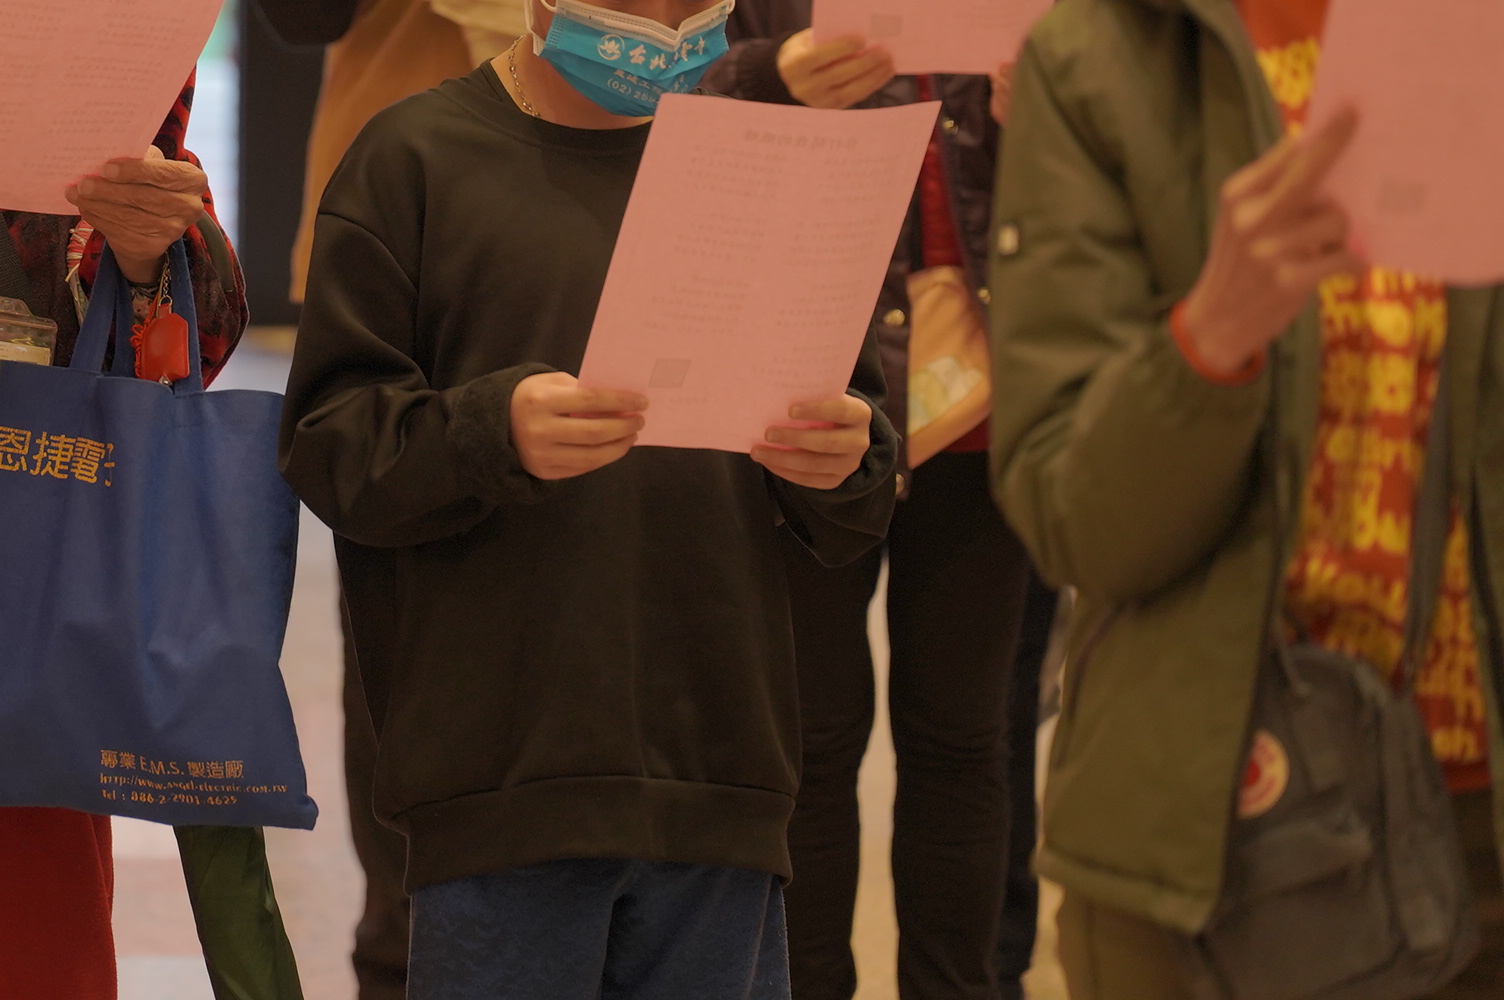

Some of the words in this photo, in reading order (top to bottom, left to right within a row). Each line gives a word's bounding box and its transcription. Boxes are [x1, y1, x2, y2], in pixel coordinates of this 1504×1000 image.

[100, 750, 136, 770] 專業
[139, 756, 185, 776] E.M.S.
[186, 760, 244, 780] 製造廠
